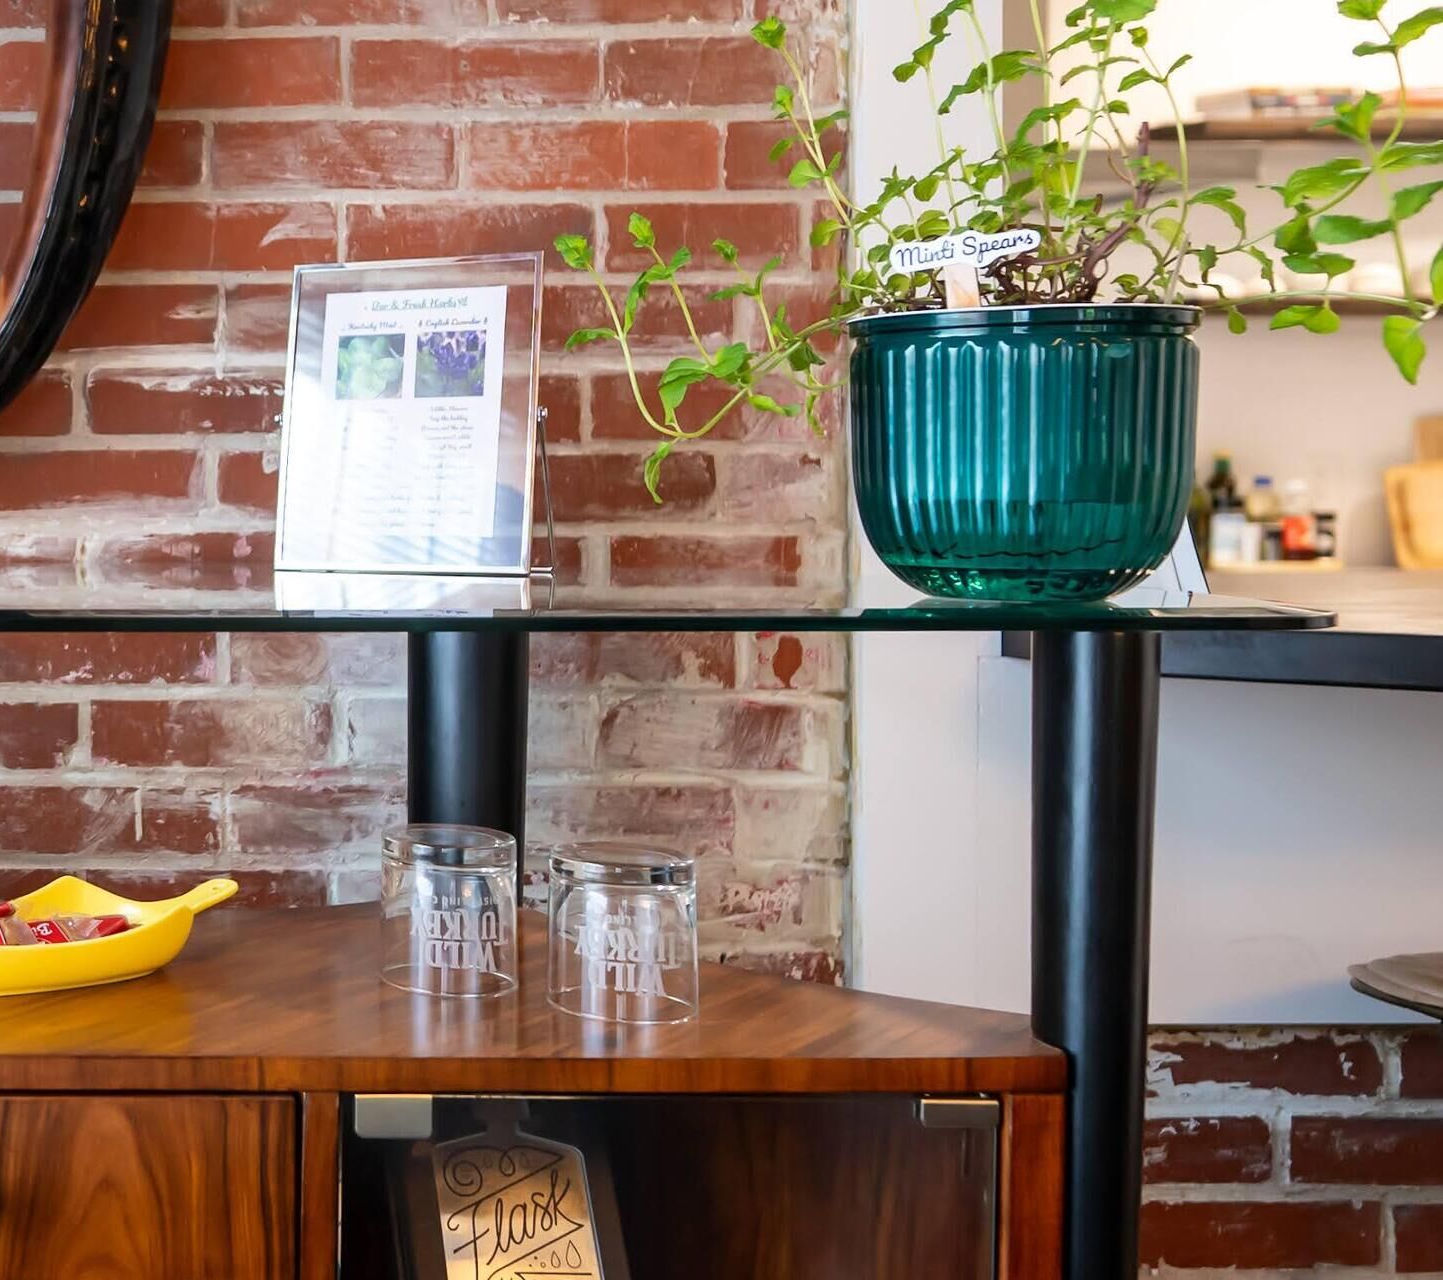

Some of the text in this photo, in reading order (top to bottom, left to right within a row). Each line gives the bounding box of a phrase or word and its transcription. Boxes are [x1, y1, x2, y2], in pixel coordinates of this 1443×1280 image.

[897, 234, 1033, 267] Minti Spears
[425, 940, 498, 973] WILD
[588, 960, 666, 997] WILD
